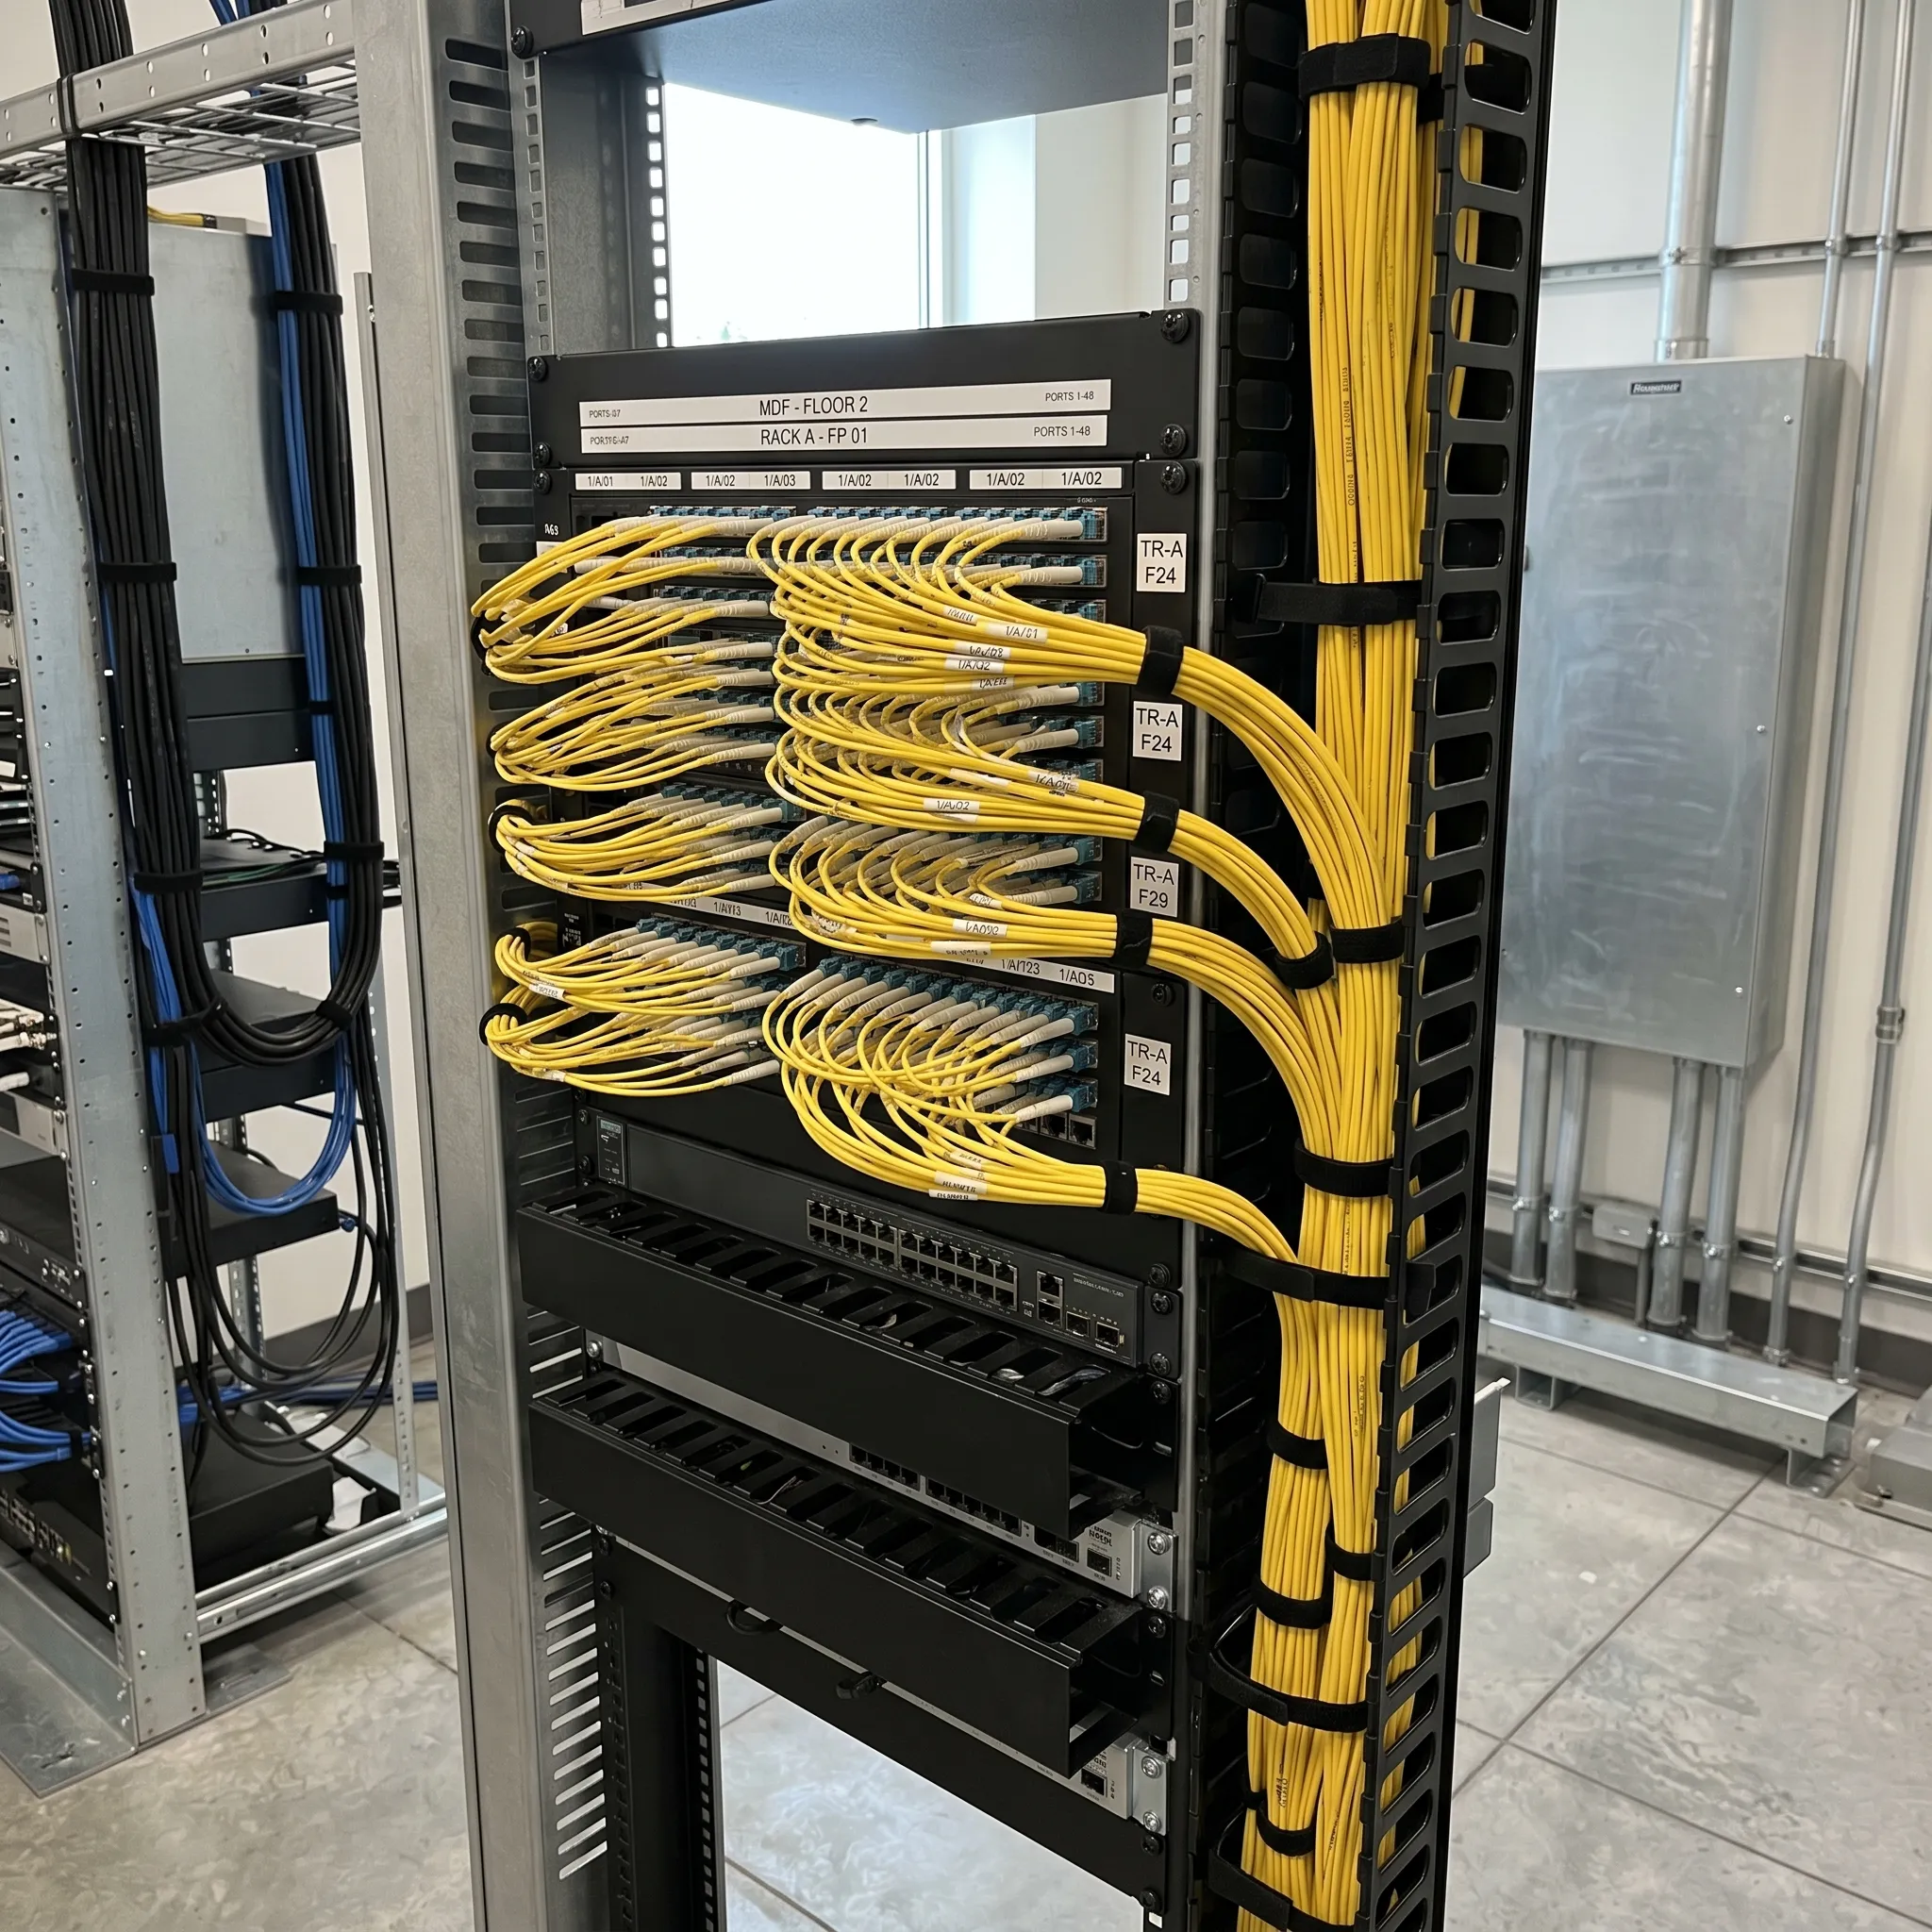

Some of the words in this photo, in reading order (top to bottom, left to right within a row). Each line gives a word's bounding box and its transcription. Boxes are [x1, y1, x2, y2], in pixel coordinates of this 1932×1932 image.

[759, 398, 791, 416] MDF
[803, 395, 855, 414] FLOOR
[858, 395, 869, 413] 2
[1044, 391, 1074, 403] PORTS
[1076, 390, 1095, 402] 1-48
[760, 428, 801, 445] RACK
[804, 427, 816, 445] A
[827, 426, 847, 444] FP
[851, 427, 868, 444] 01
[1033, 425, 1069, 438] PORTS
[1070, 425, 1091, 437] 1-48
[587, 475, 614, 488] 1/A/01
[640, 475, 669, 488] 1/A/02
[706, 475, 736, 488] 1/A/02
[763, 474, 796, 487] 1/A/03
[838, 474, 872, 487] 1/A/02
[904, 473, 940, 487] 1/A/02
[986, 472, 1025, 487] 1/A/02
[1060, 471, 1103, 486] 1/A/02
[1140, 540, 1184, 558] TR-A
[1145, 566, 1177, 585] F24
[1135, 708, 1179, 728] TR-A
[1141, 733, 1173, 753] F24
[1133, 863, 1174, 886] TR-A
[1139, 888, 1169, 908] F29
[1126, 1040, 1168, 1065] TR-A
[1132, 1064, 1161, 1086] F24
